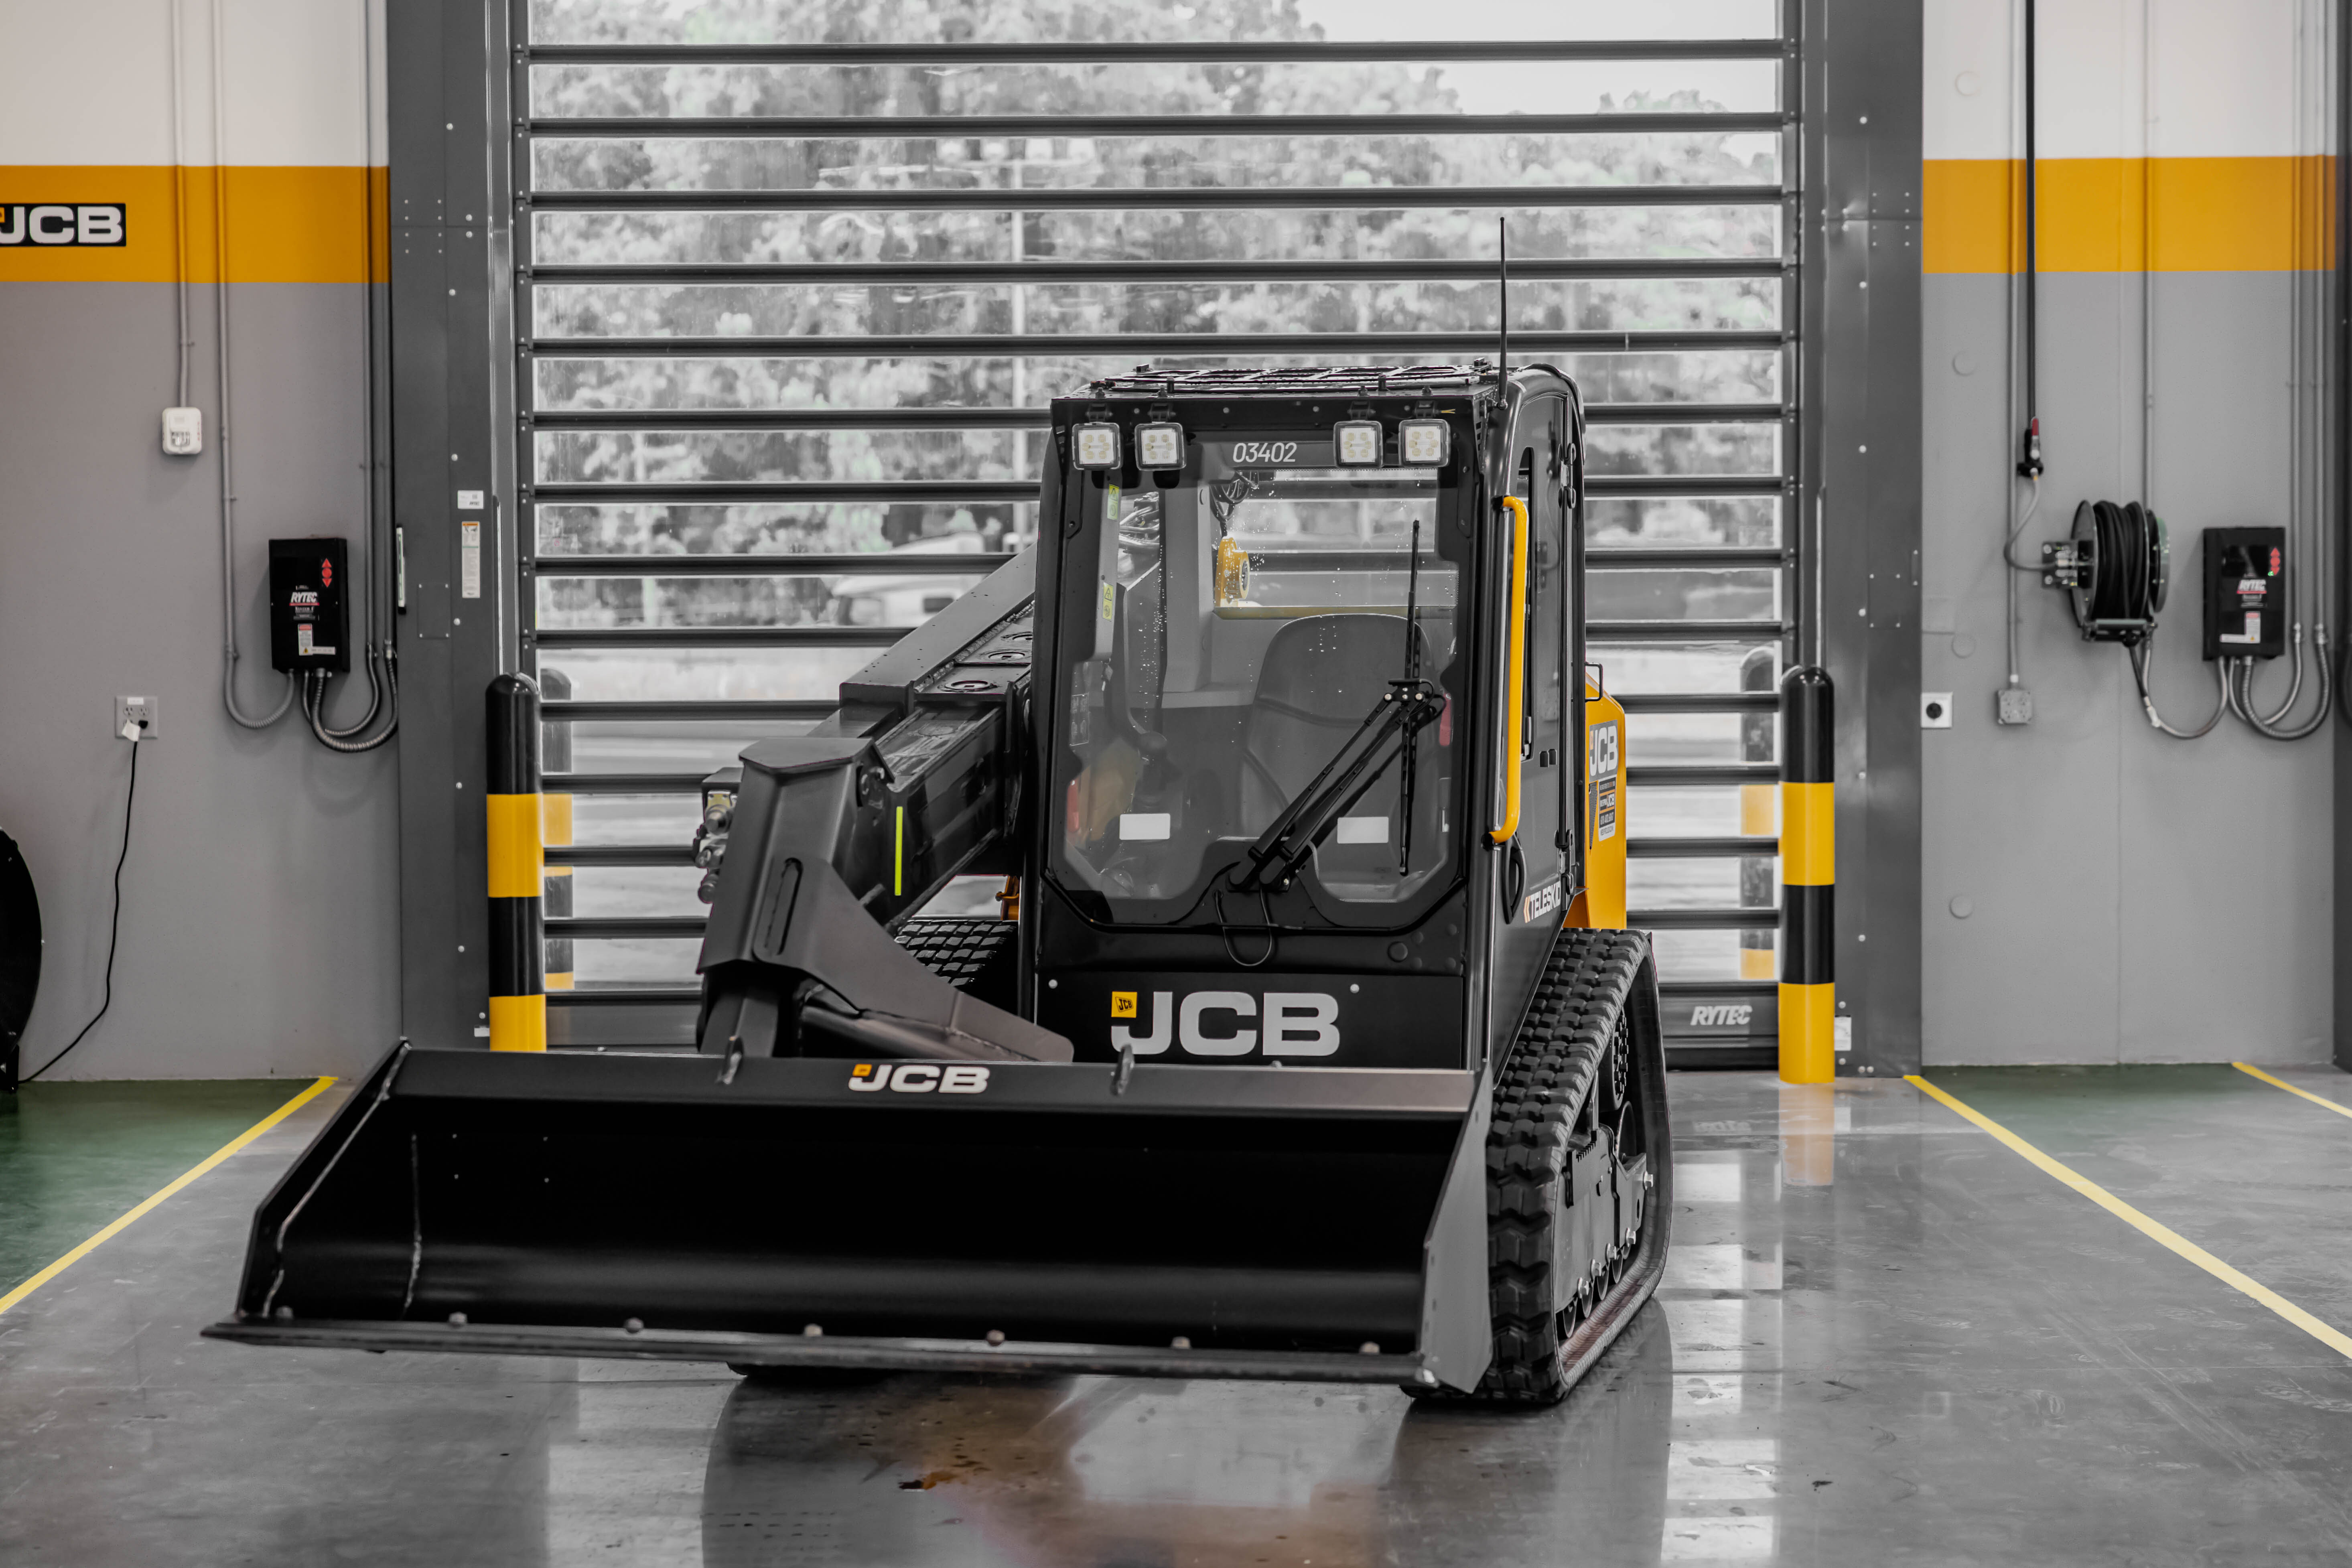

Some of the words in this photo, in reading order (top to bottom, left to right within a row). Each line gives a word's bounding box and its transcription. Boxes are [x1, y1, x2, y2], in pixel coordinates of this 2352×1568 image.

[0, 206, 122, 244] JCB
[1233, 442, 1297, 462] 03402
[290, 592, 317, 603] RYTEC
[1589, 725, 1617, 777] JCB
[1530, 880, 1561, 920] TELESKID
[1119, 998, 1132, 1010] JCB
[1690, 1005, 1753, 1025] RYTEC
[1111, 991, 1340, 1056] JCB
[848, 1064, 990, 1093] JCB
